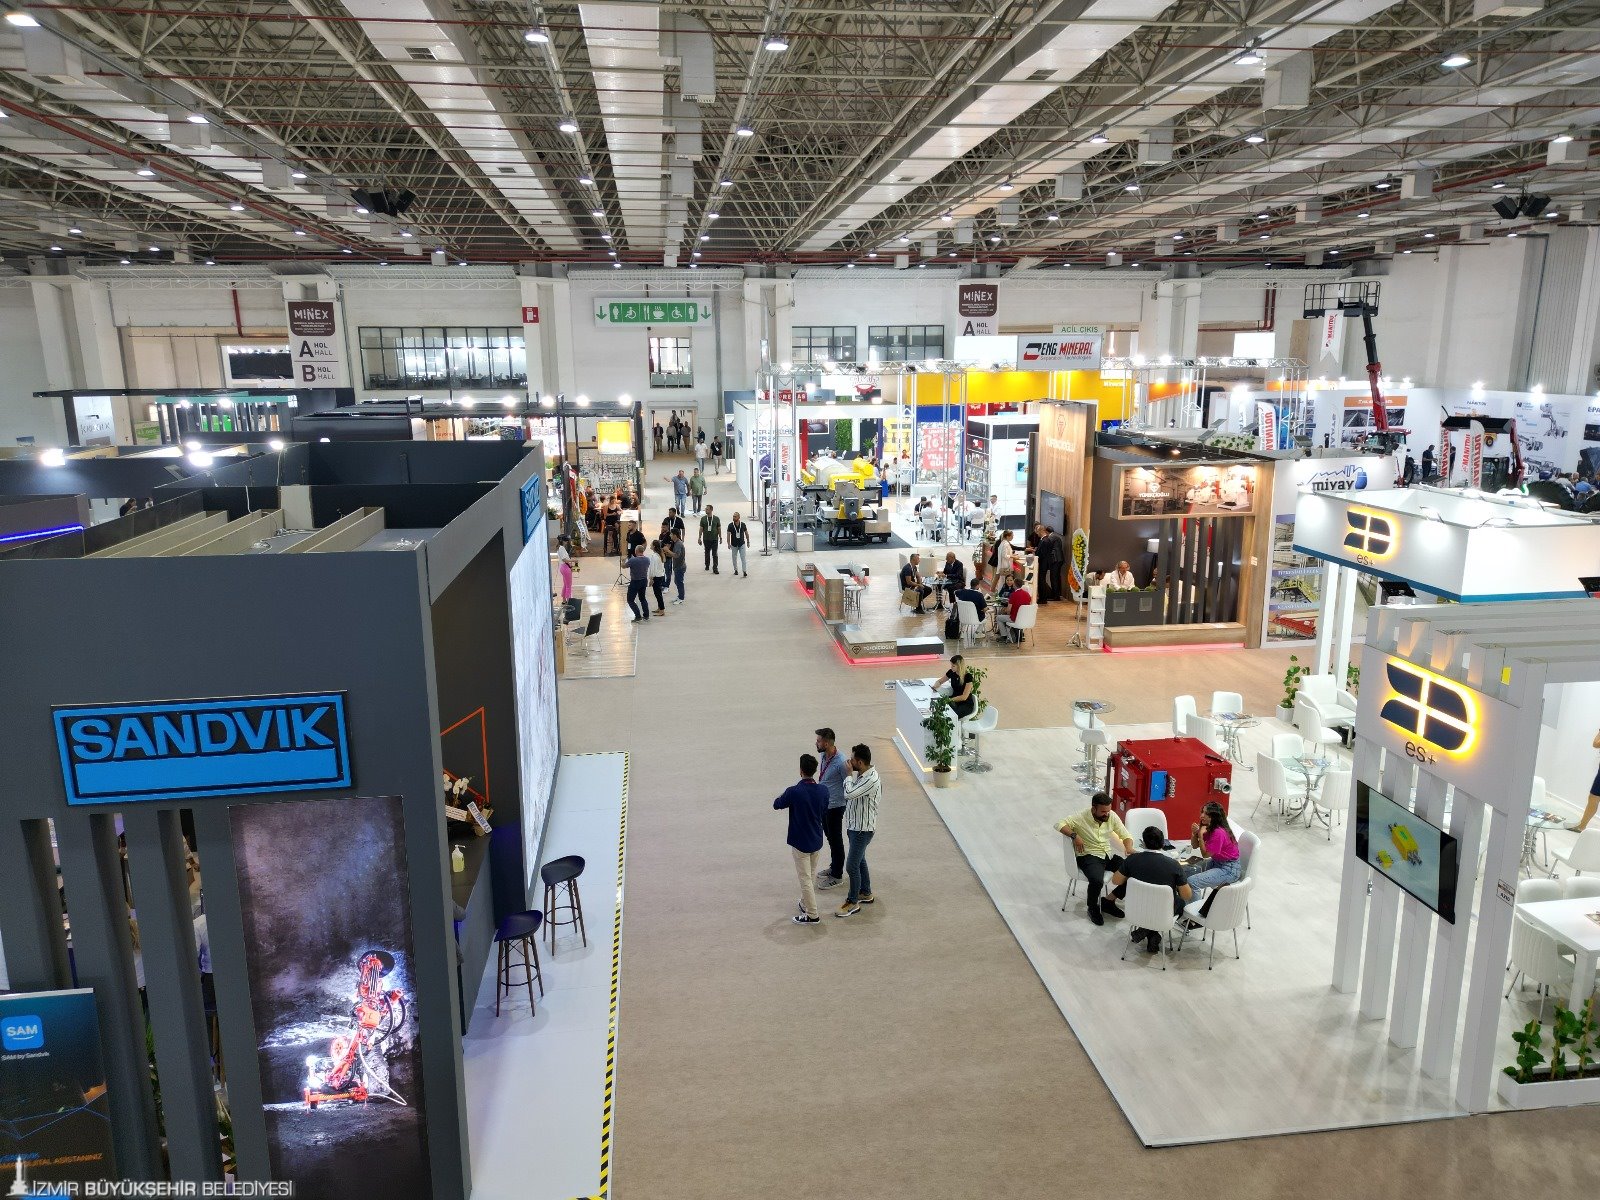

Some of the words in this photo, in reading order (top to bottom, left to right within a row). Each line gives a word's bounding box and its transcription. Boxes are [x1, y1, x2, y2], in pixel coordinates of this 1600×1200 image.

[963, 321, 976, 336] A
[299, 340, 315, 358] A
[1059, 341, 1095, 355] MINERAL
[302, 364, 316, 382] B
[1462, 433, 1471, 466] MANITOU
[1312, 478, 1354, 491] miyay
[1356, 554, 1374, 566] es+
[70, 706, 336, 761] SANDVIK
[1405, 741, 1436, 765] es+
[6, 1024, 38, 1037] SAM
